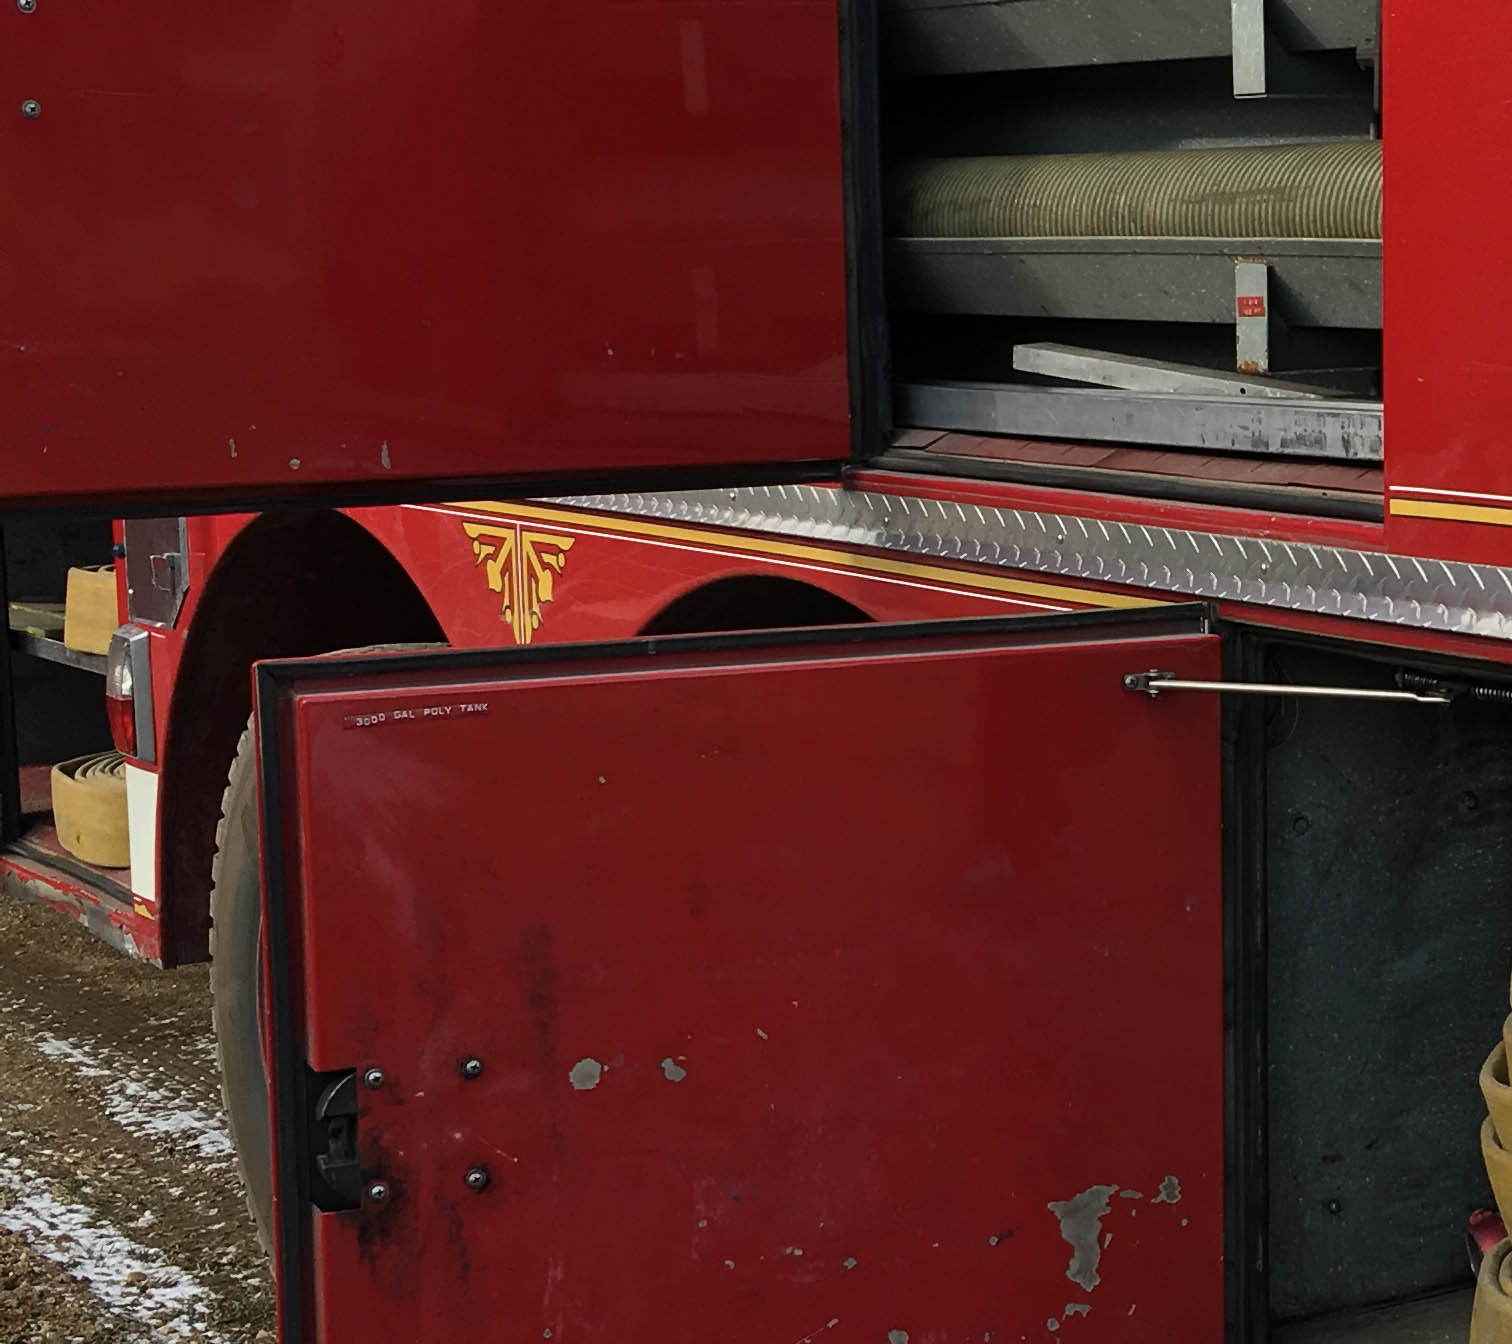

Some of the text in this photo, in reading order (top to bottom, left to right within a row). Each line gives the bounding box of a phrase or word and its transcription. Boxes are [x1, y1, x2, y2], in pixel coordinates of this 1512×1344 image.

[355, 703, 489, 727] 3000 GAL POLY TANK
